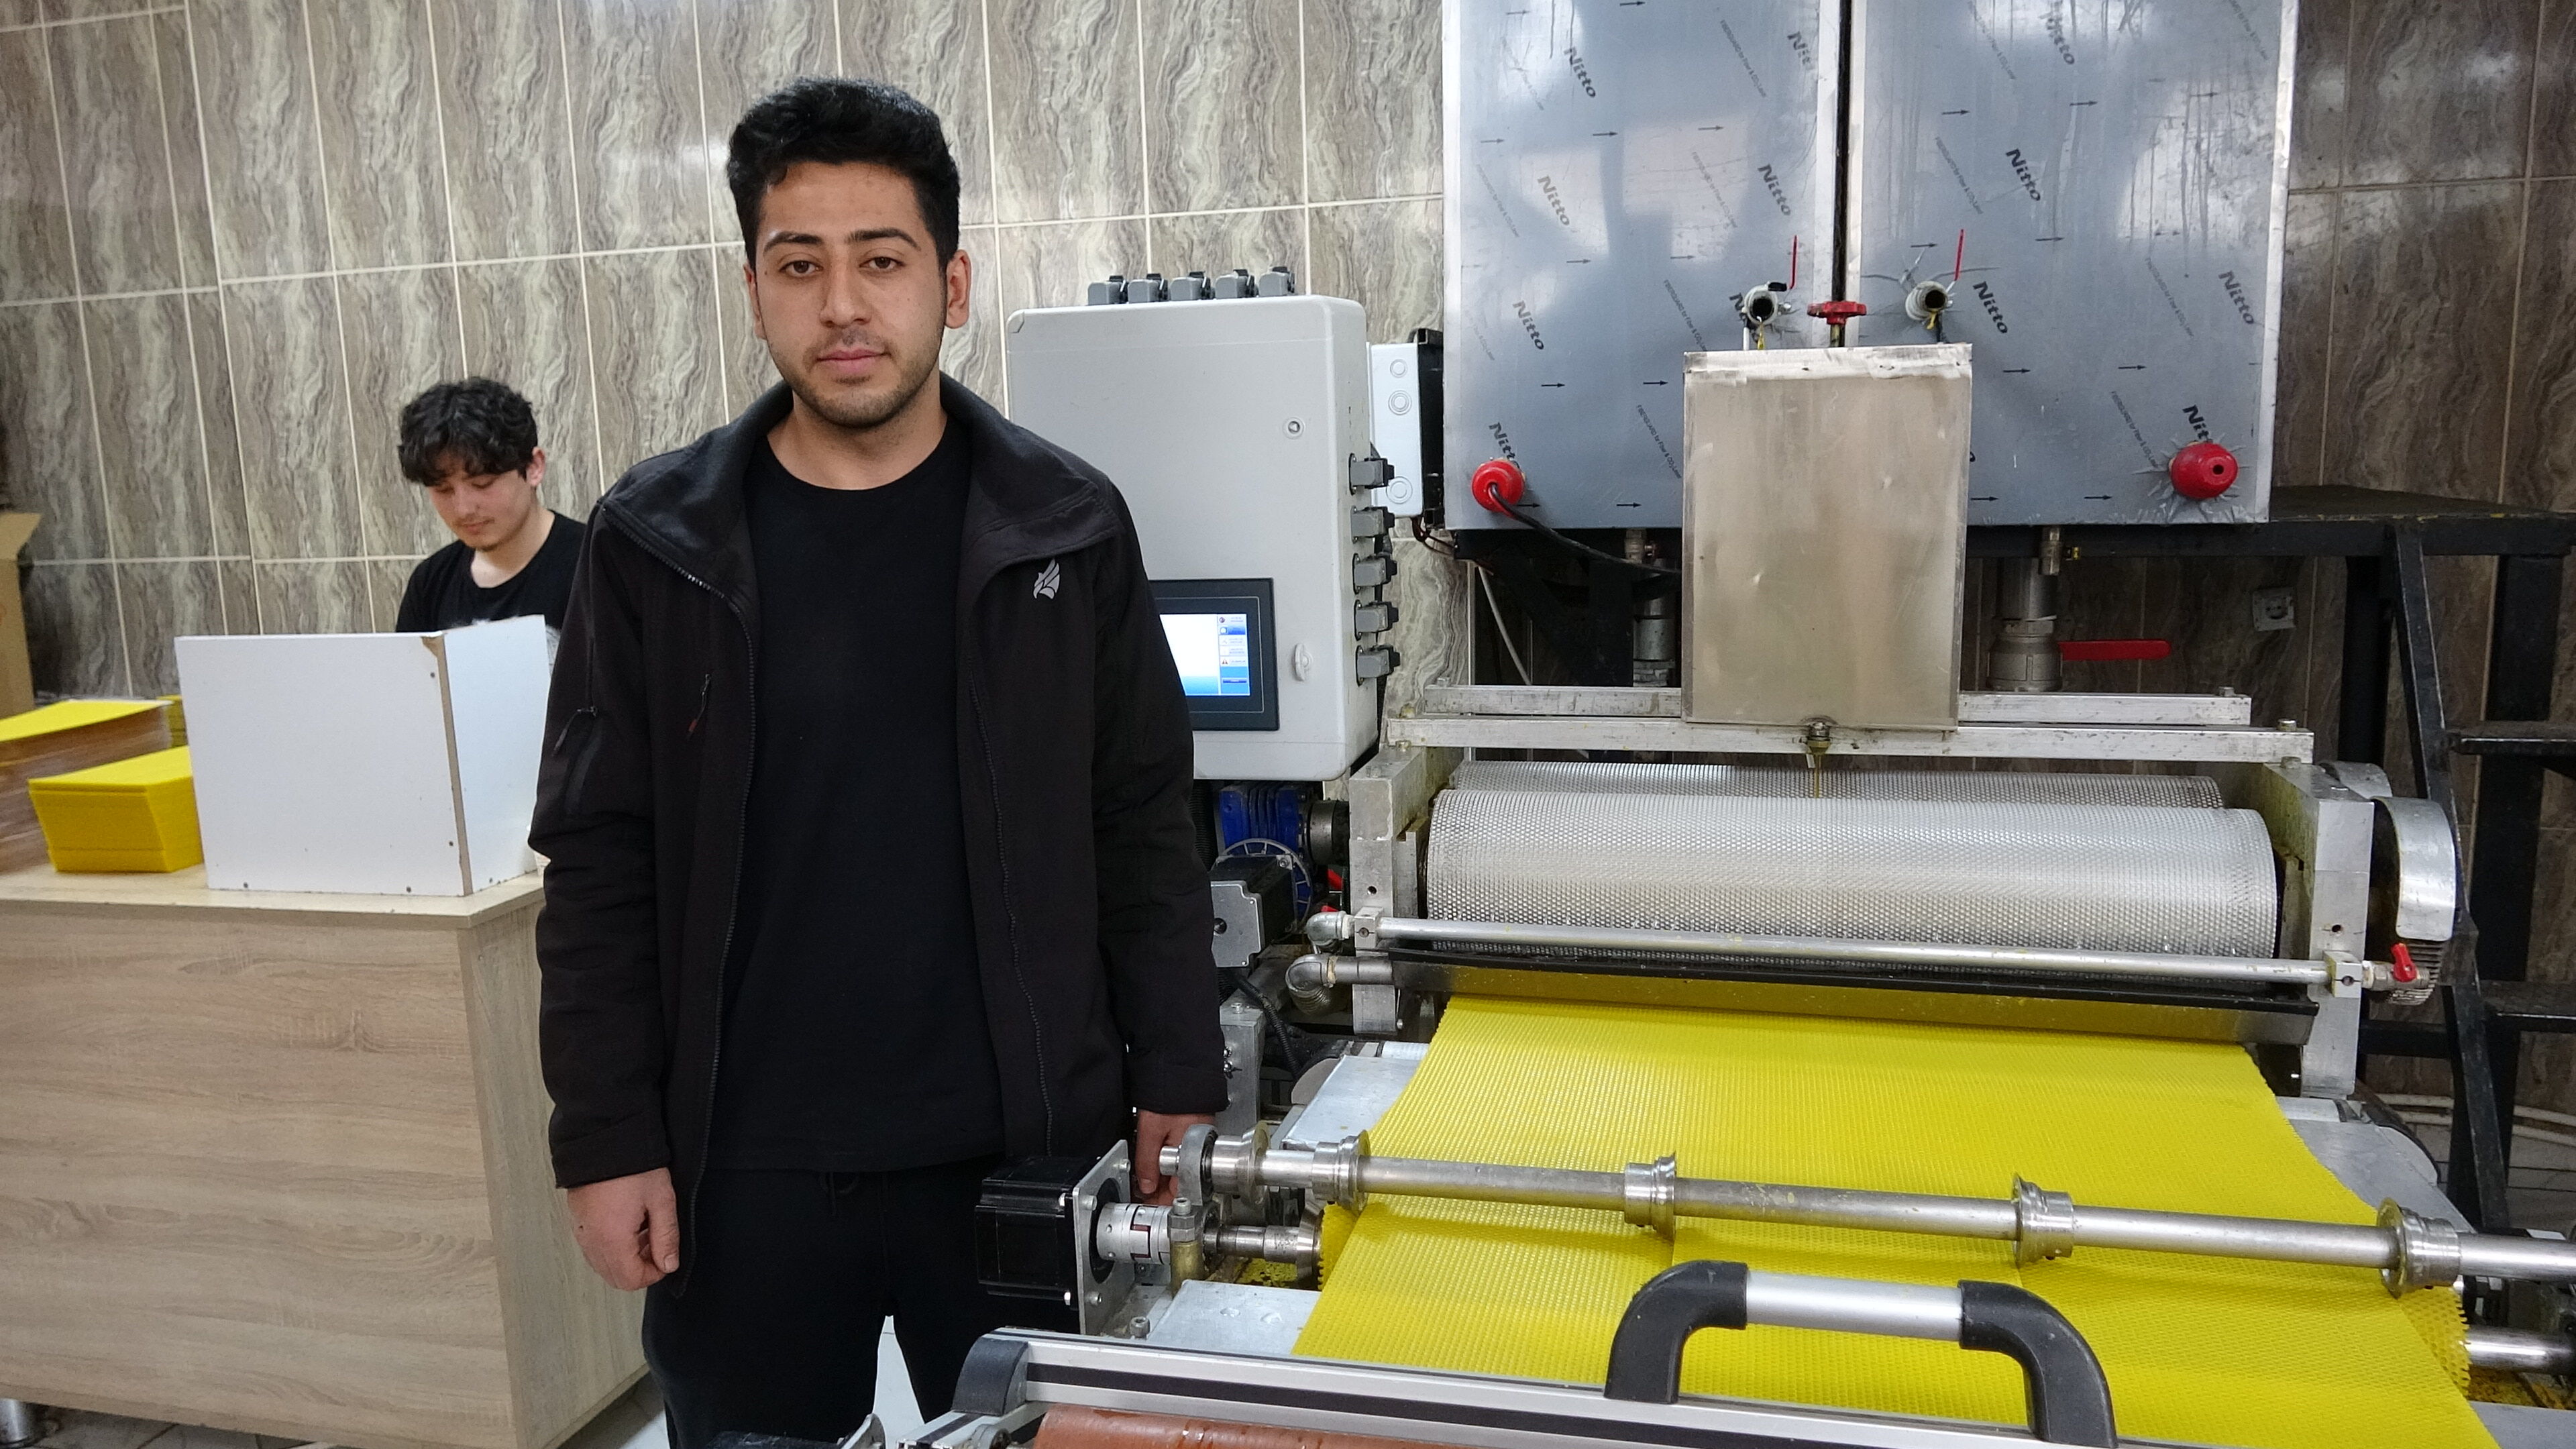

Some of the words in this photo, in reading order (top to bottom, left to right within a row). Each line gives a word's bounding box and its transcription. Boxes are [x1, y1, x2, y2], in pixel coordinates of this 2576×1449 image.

[1564, 47, 1596, 97] Nitto
[1788, 31, 1812, 65] Nit
[1758, 164, 1790, 215] Nitto
[2006, 148, 2041, 201] Nitto
[1538, 175, 1570, 225] Nitto
[1972, 281, 2008, 333] Nitto
[2218, 270, 2254, 324] Nitto
[1513, 300, 1544, 350] Nitto
[2182, 405, 2212, 442] Nit
